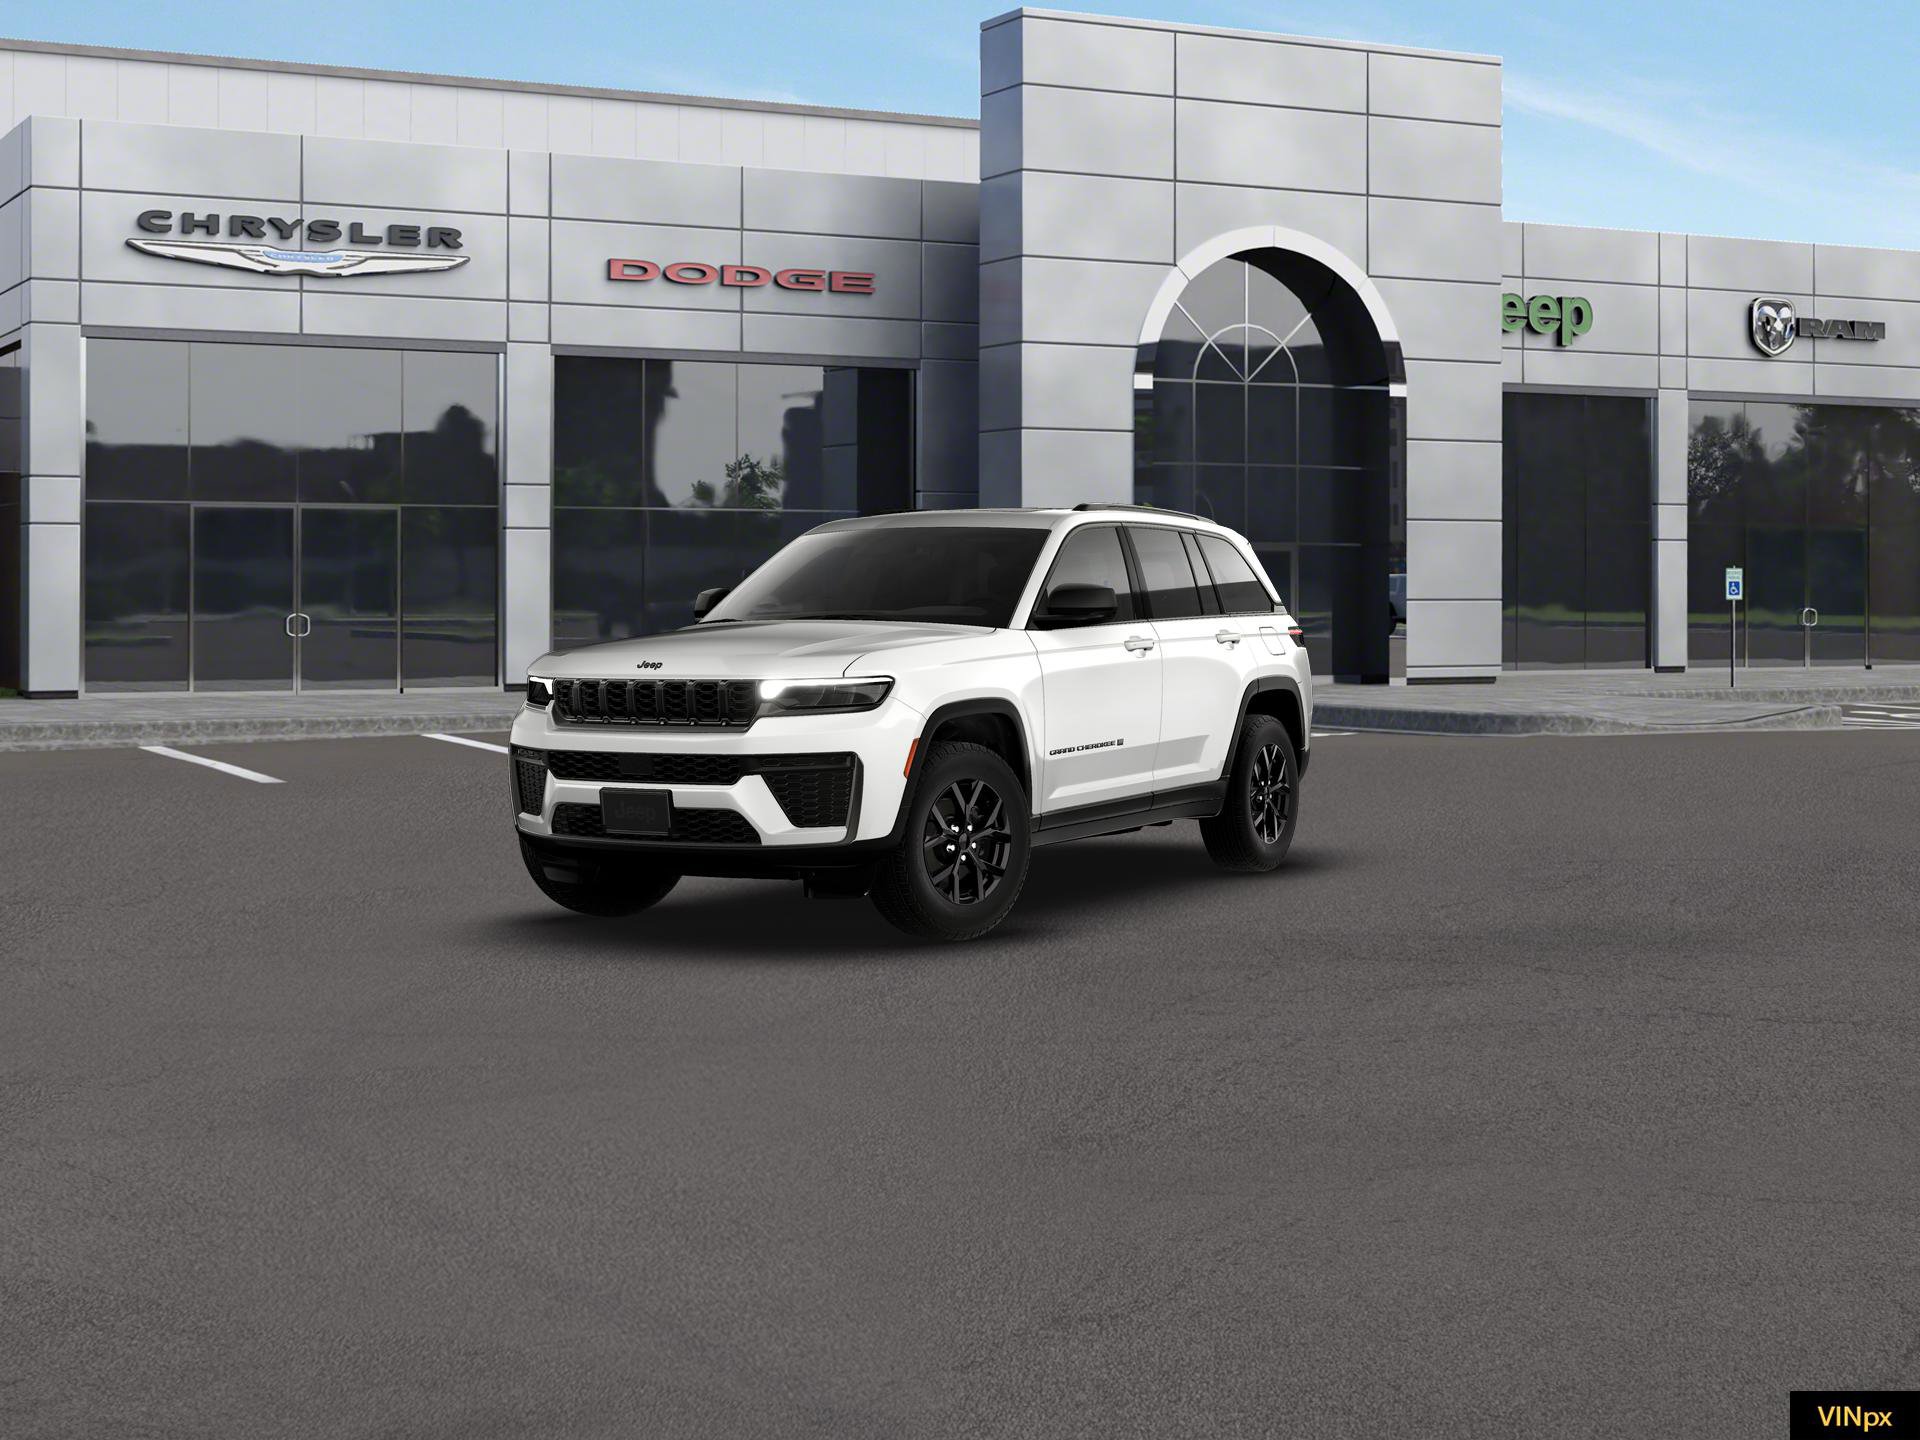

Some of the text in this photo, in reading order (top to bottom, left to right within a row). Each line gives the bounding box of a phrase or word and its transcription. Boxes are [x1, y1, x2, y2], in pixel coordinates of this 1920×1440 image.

[137, 209, 464, 249] CHRYSLER
[607, 257, 877, 294] DODGE
[1502, 292, 1594, 347] eep
[1796, 317, 1886, 342] RAM
[636, 660, 663, 671] Jeep
[1049, 740, 1116, 756] GRAND CHEROKEE
